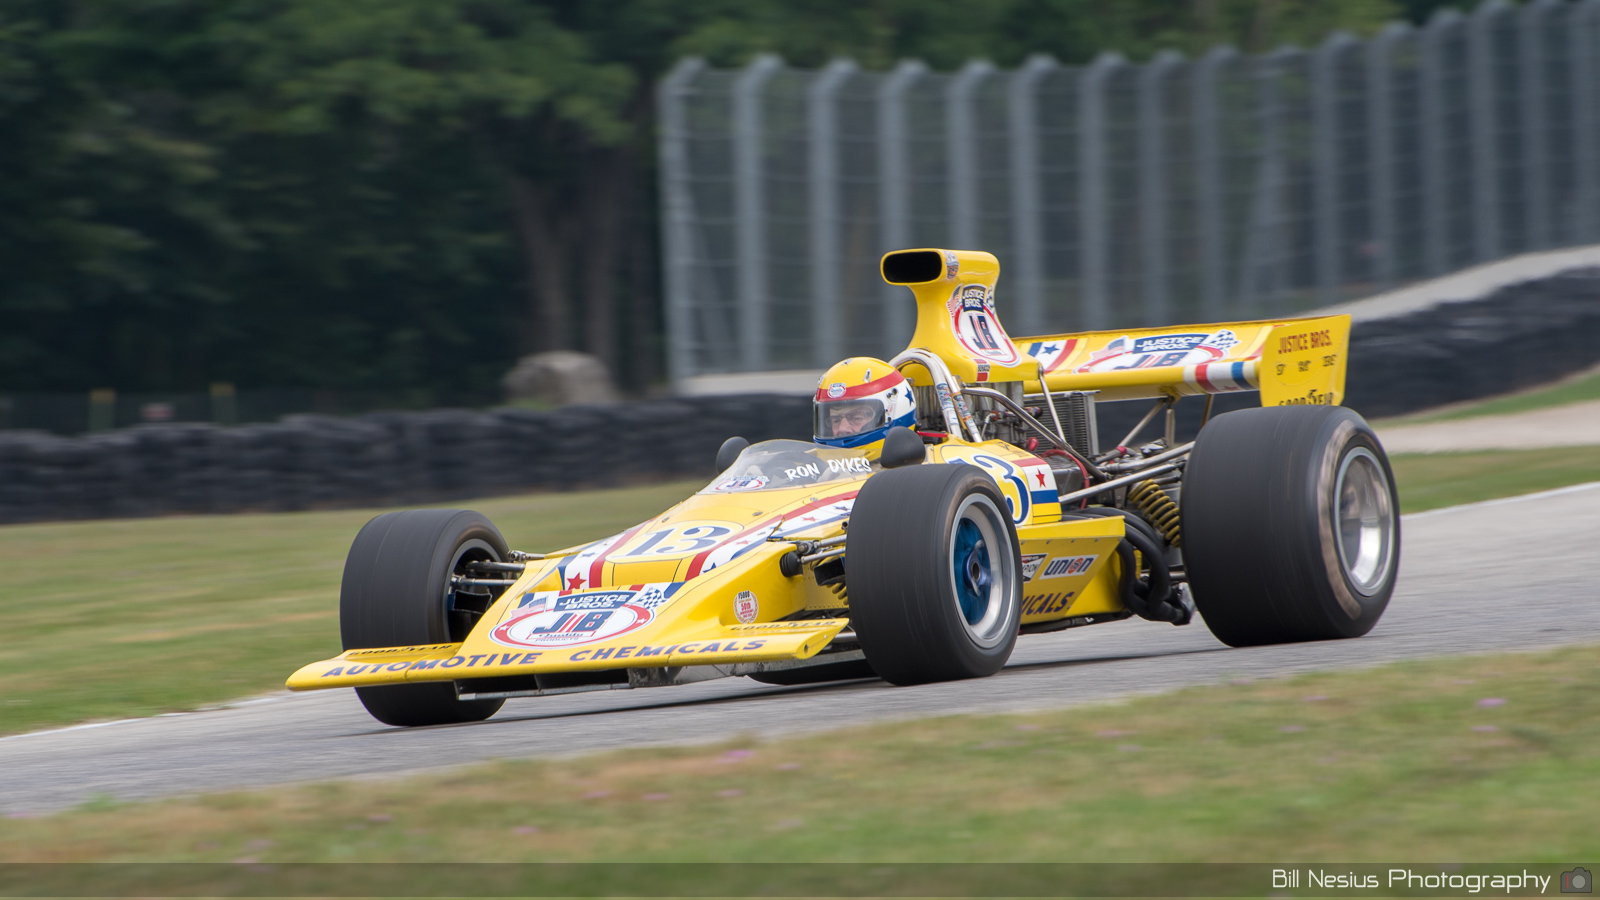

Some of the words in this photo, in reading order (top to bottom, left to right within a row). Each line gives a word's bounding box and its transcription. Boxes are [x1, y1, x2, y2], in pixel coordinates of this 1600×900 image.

[963, 289, 985, 300] JUSTICE
[964, 299, 982, 308] BROS.
[969, 315, 1001, 350] JB
[1136, 336, 1204, 348] JUSTICE
[1142, 344, 1190, 352] BROS.
[1278, 333, 1308, 354] JUSTICE
[1113, 352, 1190, 370] JB
[784, 462, 821, 481] RON
[826, 457, 873, 474] DYKES
[947, 454, 1029, 525] 3
[616, 525, 731, 557] 13
[1043, 557, 1095, 576] UNION
[559, 594, 629, 606] JUSTICE
[565, 601, 616, 610] BROS.
[532, 611, 615, 634] JB
[321, 652, 543, 678] AUTOMOTIVE
[569, 639, 768, 662] CHEMICALS
